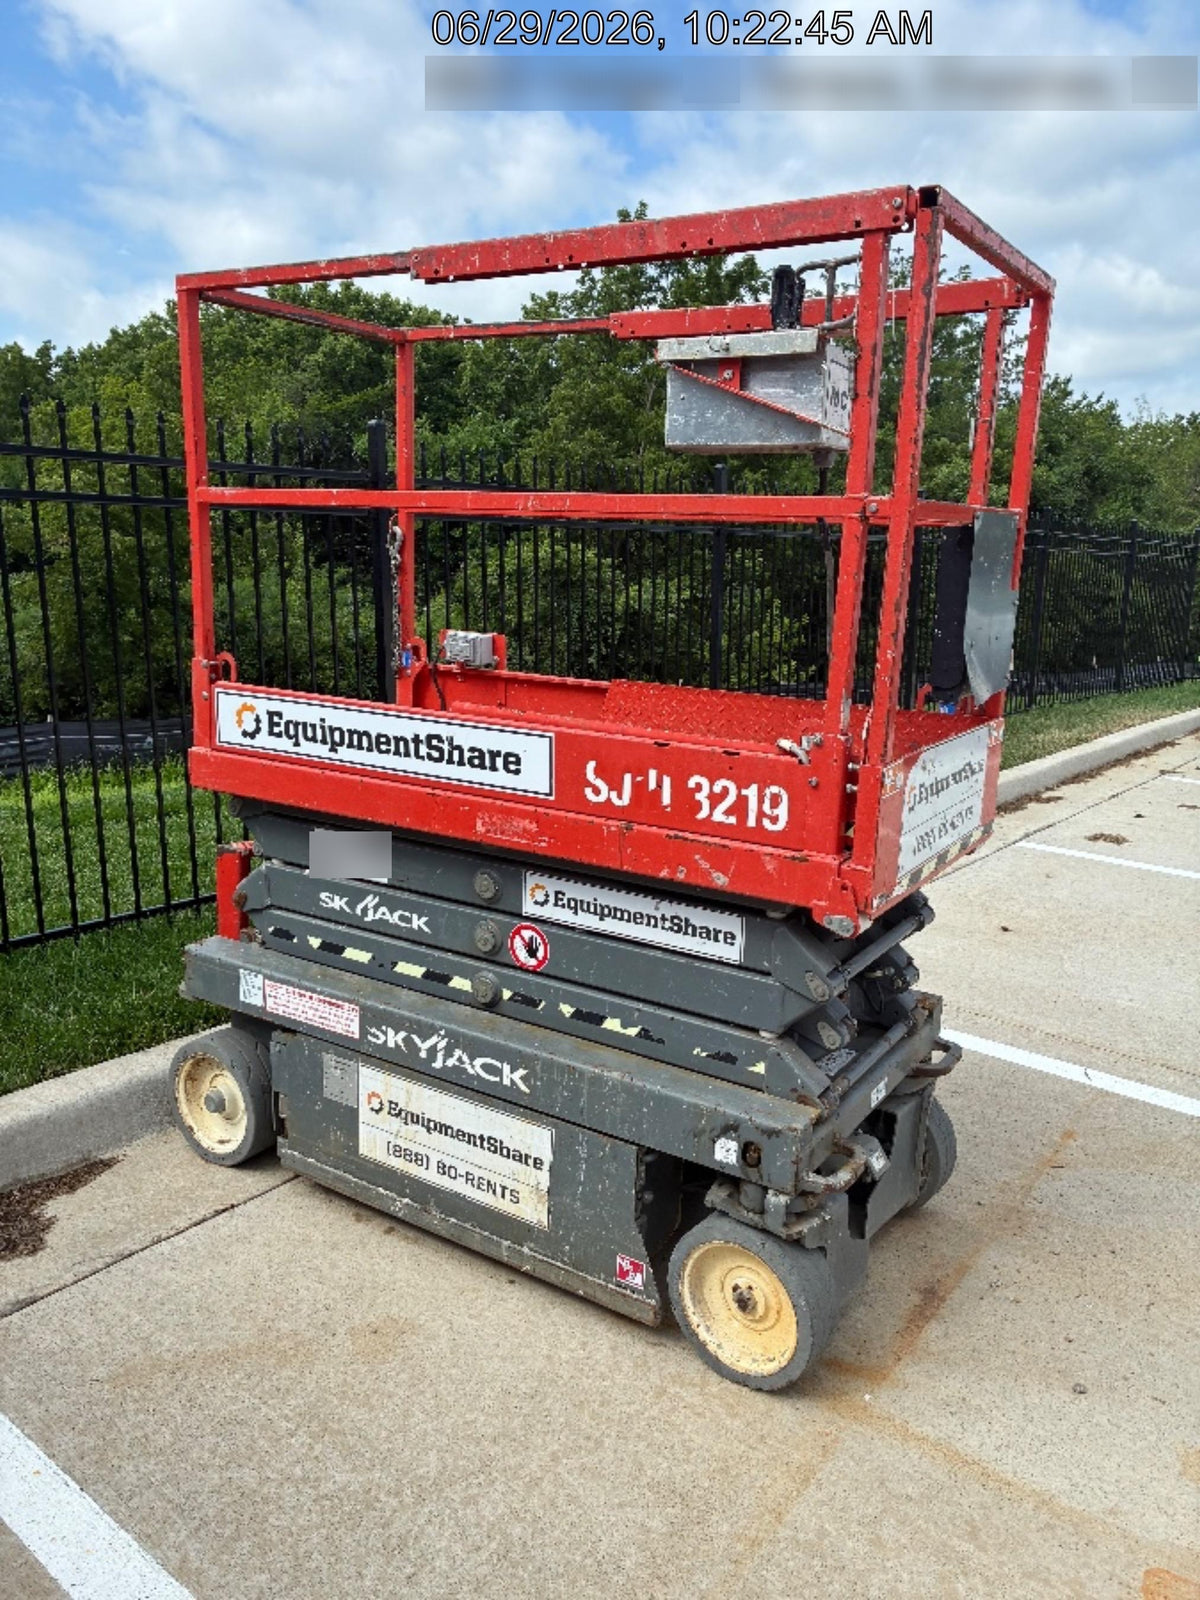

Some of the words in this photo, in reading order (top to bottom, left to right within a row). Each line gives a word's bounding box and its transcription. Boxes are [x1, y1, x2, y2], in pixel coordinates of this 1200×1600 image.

[266, 709, 522, 776] EquipmentShare
[687, 774, 789, 831] 3219
[553, 890, 737, 947] EquipmentShare
[366, 1025, 530, 1094] SKYJACK
[387, 1100, 544, 1171] EquipmentShare
